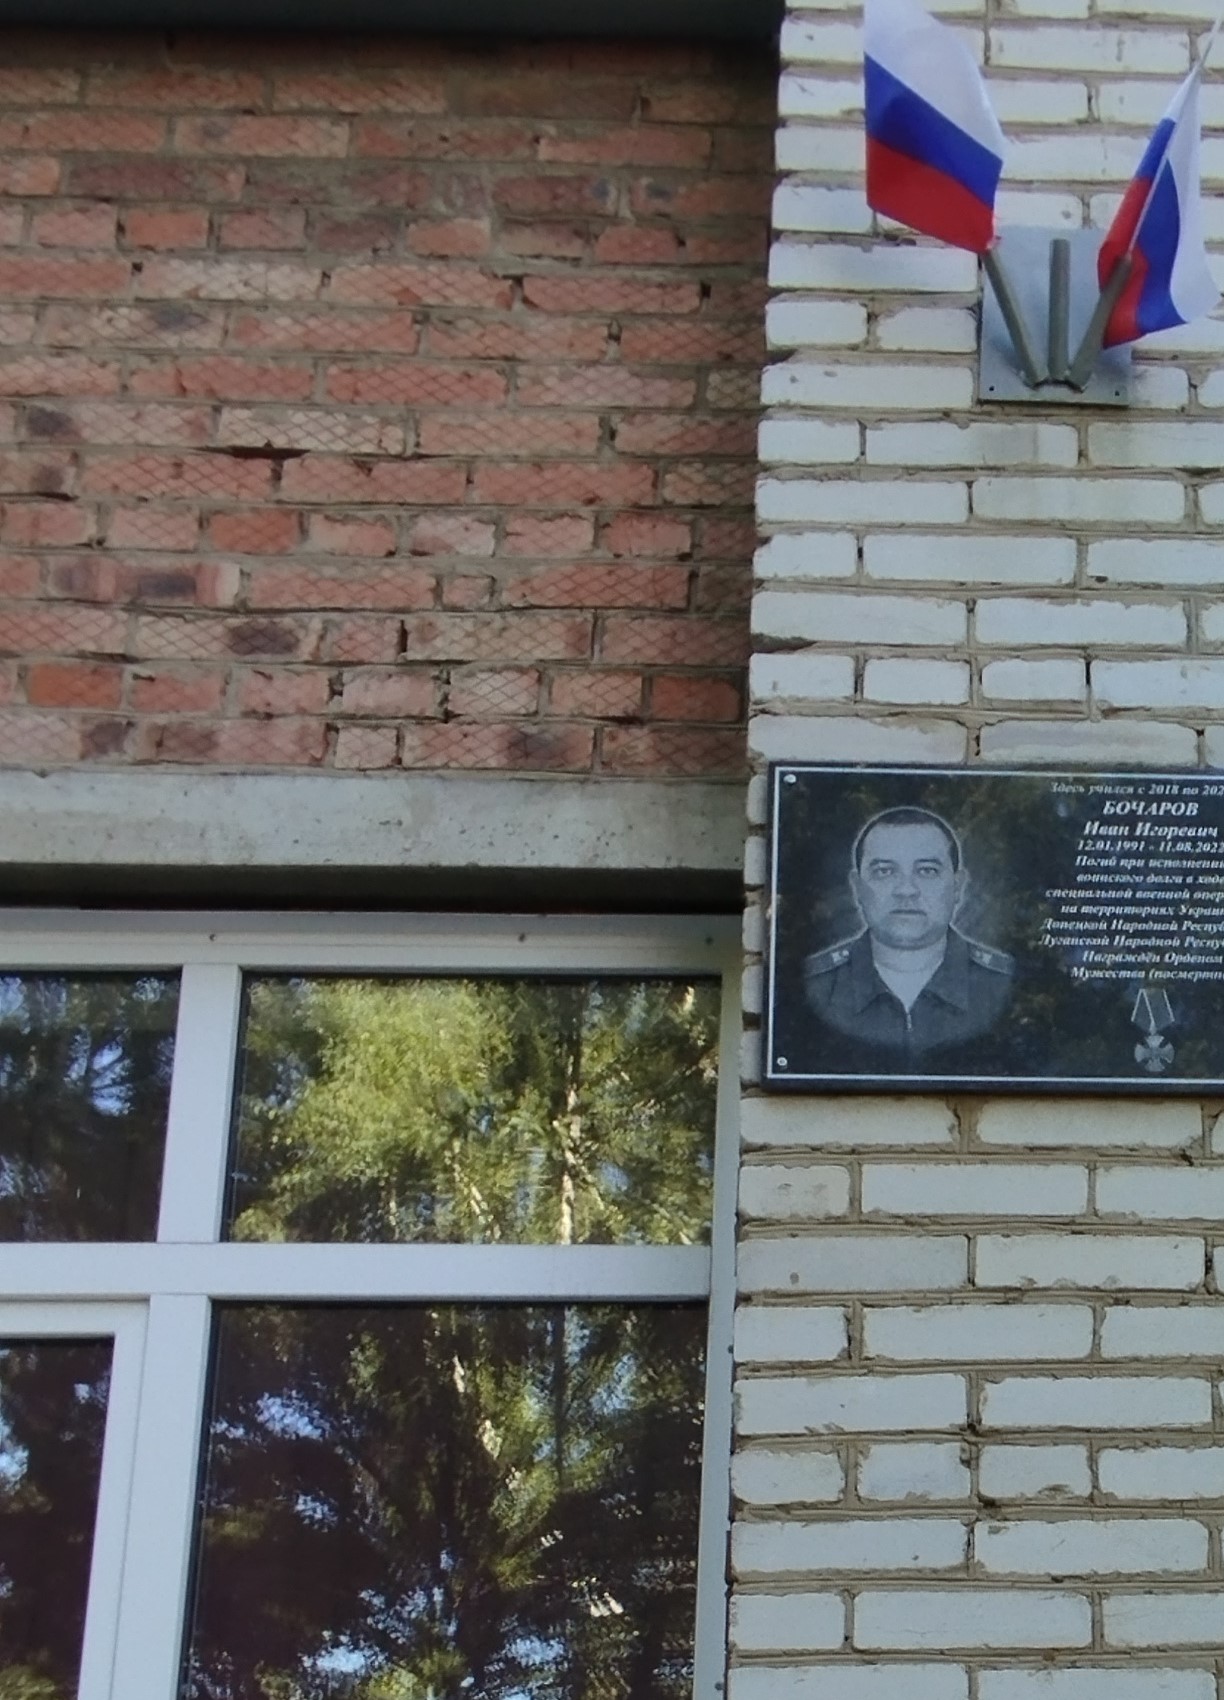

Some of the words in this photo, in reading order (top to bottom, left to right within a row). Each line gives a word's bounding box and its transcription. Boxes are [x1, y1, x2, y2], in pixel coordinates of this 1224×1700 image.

[1050, 782, 1085, 794] Здесь
[1088, 783, 1134, 796] учился
[1138, 786, 1145, 795] с
[1148, 783, 1178, 795] 2018
[1182, 786, 1199, 796] по
[1102, 801, 1199, 816] БОЧАРОВ
[1083, 821, 1129, 837] Иван
[1134, 822, 1218, 840] Игоревич
[1077, 840, 1145, 851] 12.01.1991
[1075, 855, 1117, 868] Погиб
[1119, 858, 1145, 870] при
[1076, 873, 1144, 884] воинского
[1146, 873, 1184, 885] долга
[1186, 875, 1193, 884] в
[1045, 887, 1133, 901] специальной
[1135, 888, 1190, 900] военной
[1060, 906, 1078, 915] на
[1080, 905, 1176, 918] территориях
[1042, 918, 1108, 933] Донецкой
[1110, 919, 1179, 933] Народной
[1040, 934, 1111, 949] Луганской
[1113, 935, 1181, 950] Народной
[1082, 951, 1161, 967] Награждён
[1163, 952, 1224, 966] Орденом
[1070, 967, 1146, 982] Мужества
